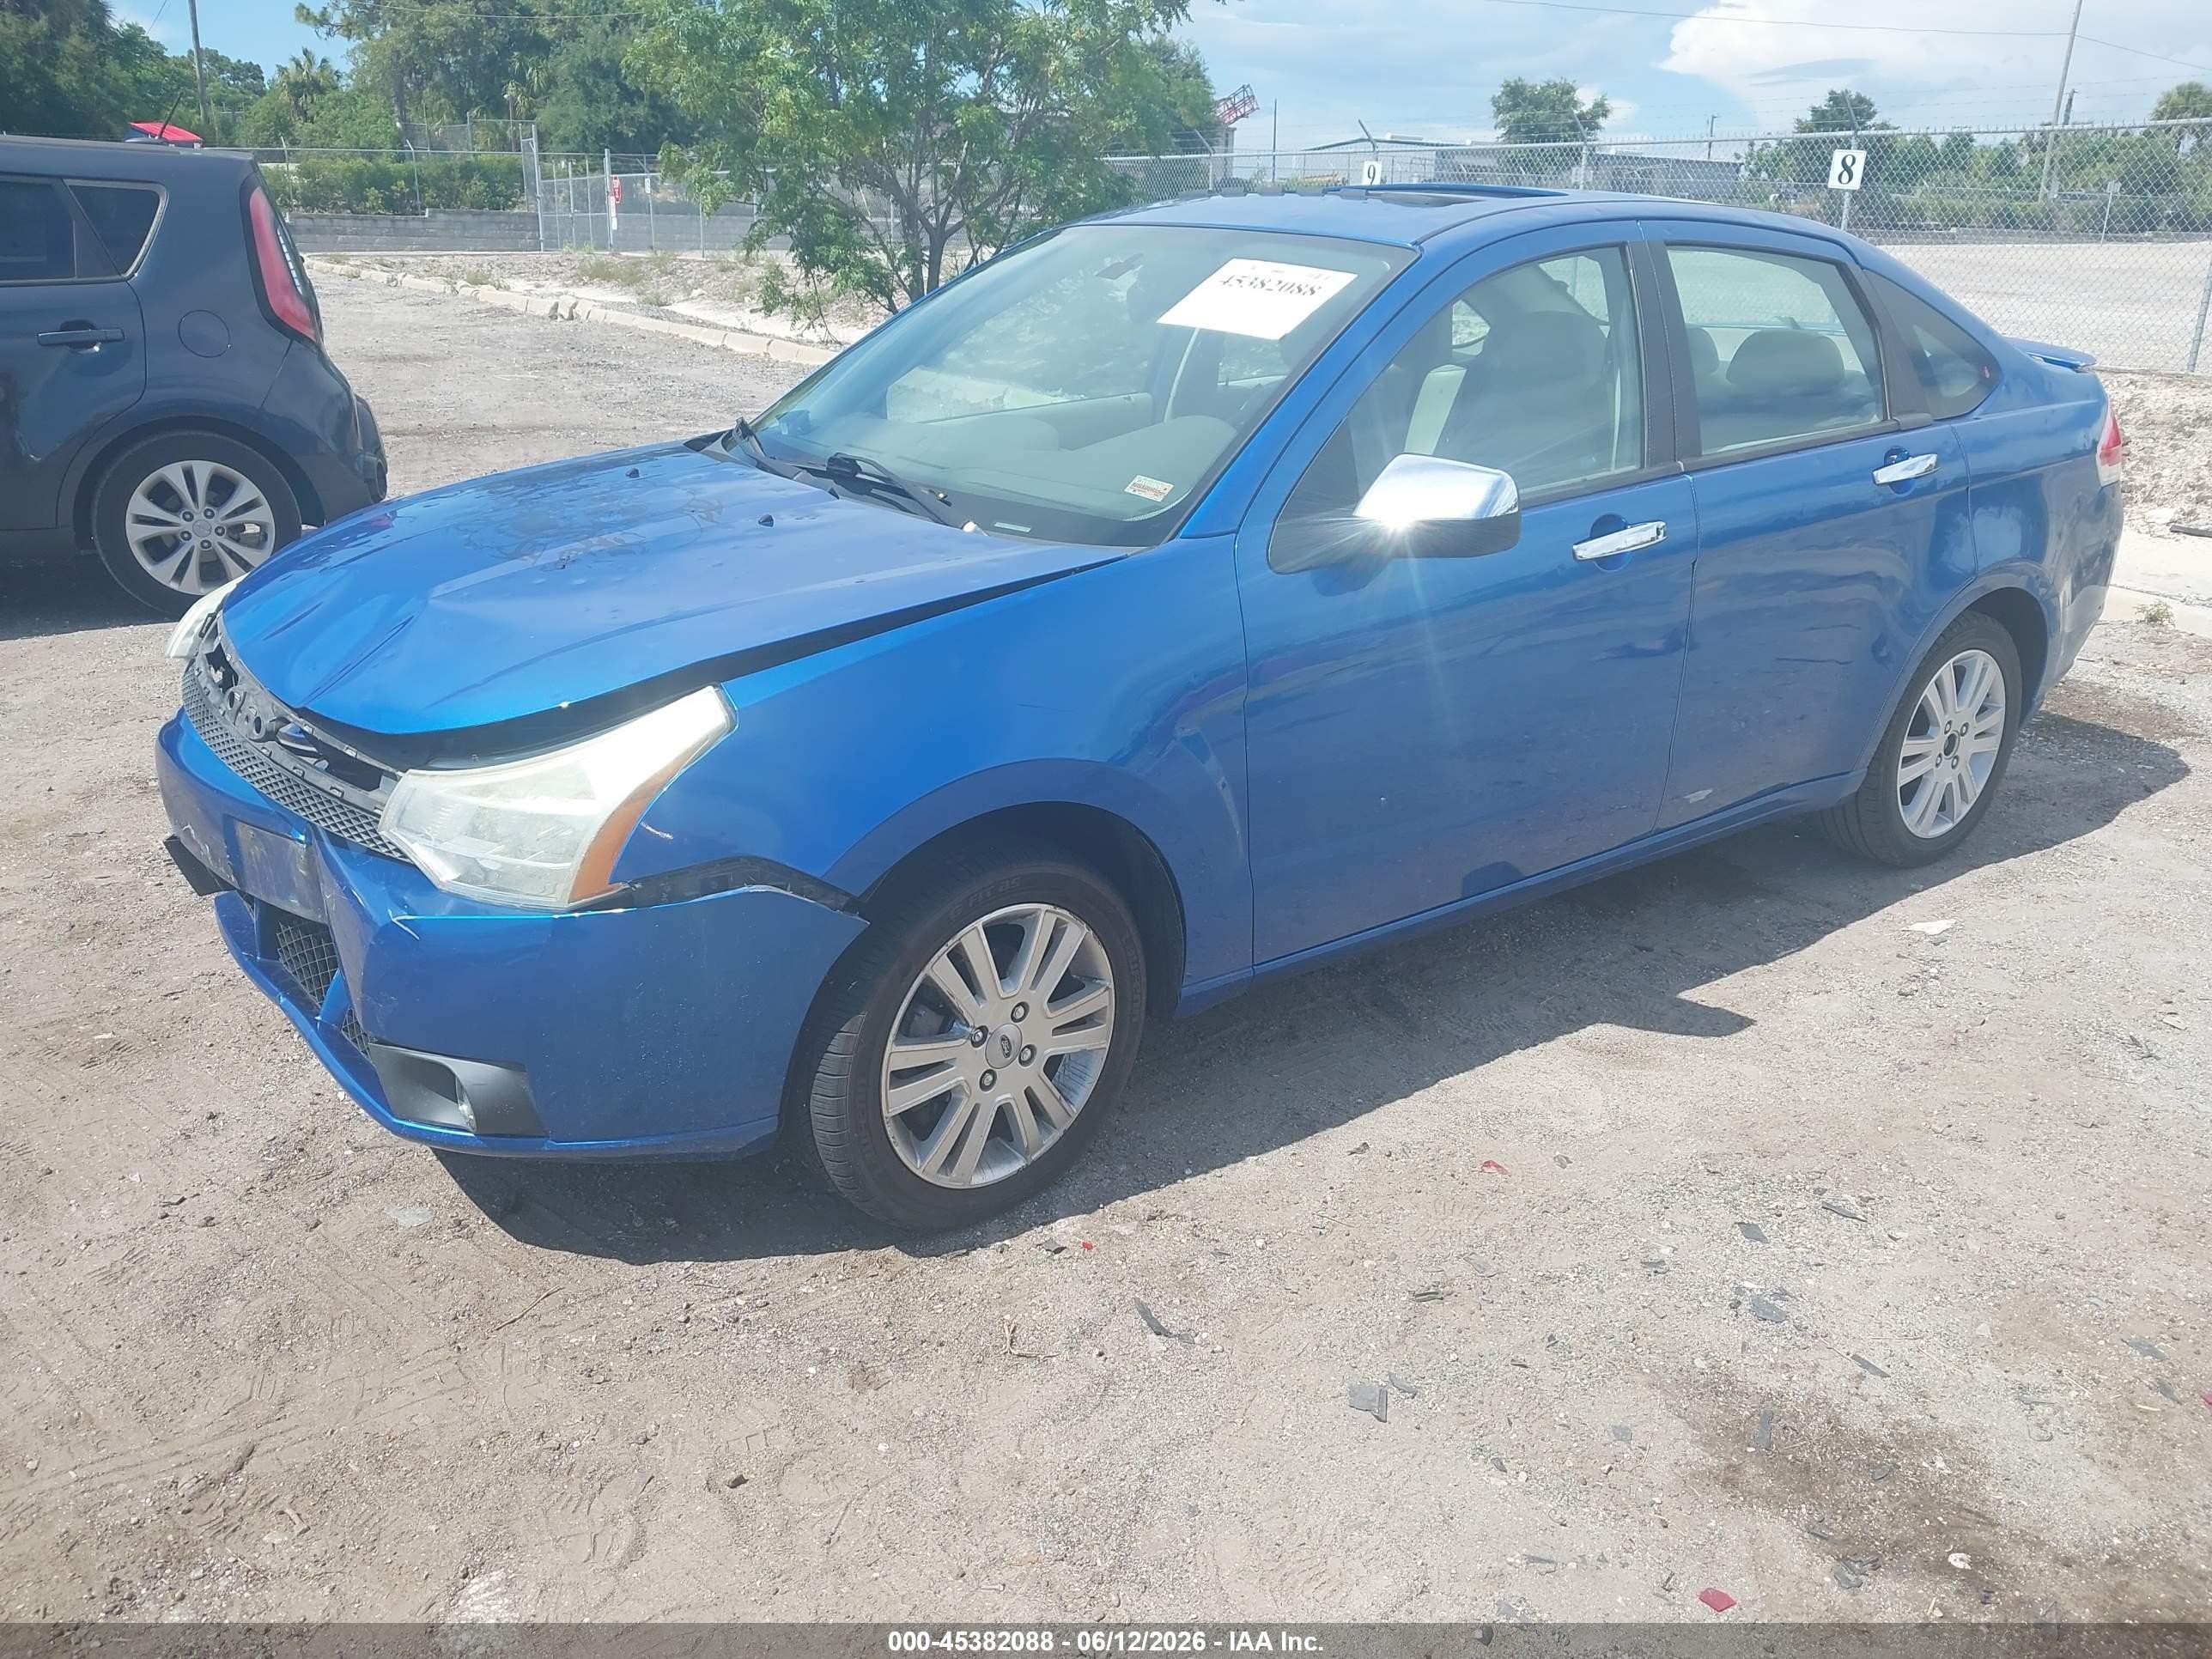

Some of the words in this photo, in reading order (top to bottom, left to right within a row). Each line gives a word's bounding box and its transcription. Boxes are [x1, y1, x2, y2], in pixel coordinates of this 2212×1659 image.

[1367, 164, 1376, 185] 9
[1838, 154, 1856, 185] 8
[1219, 274, 1322, 296] 45382088
